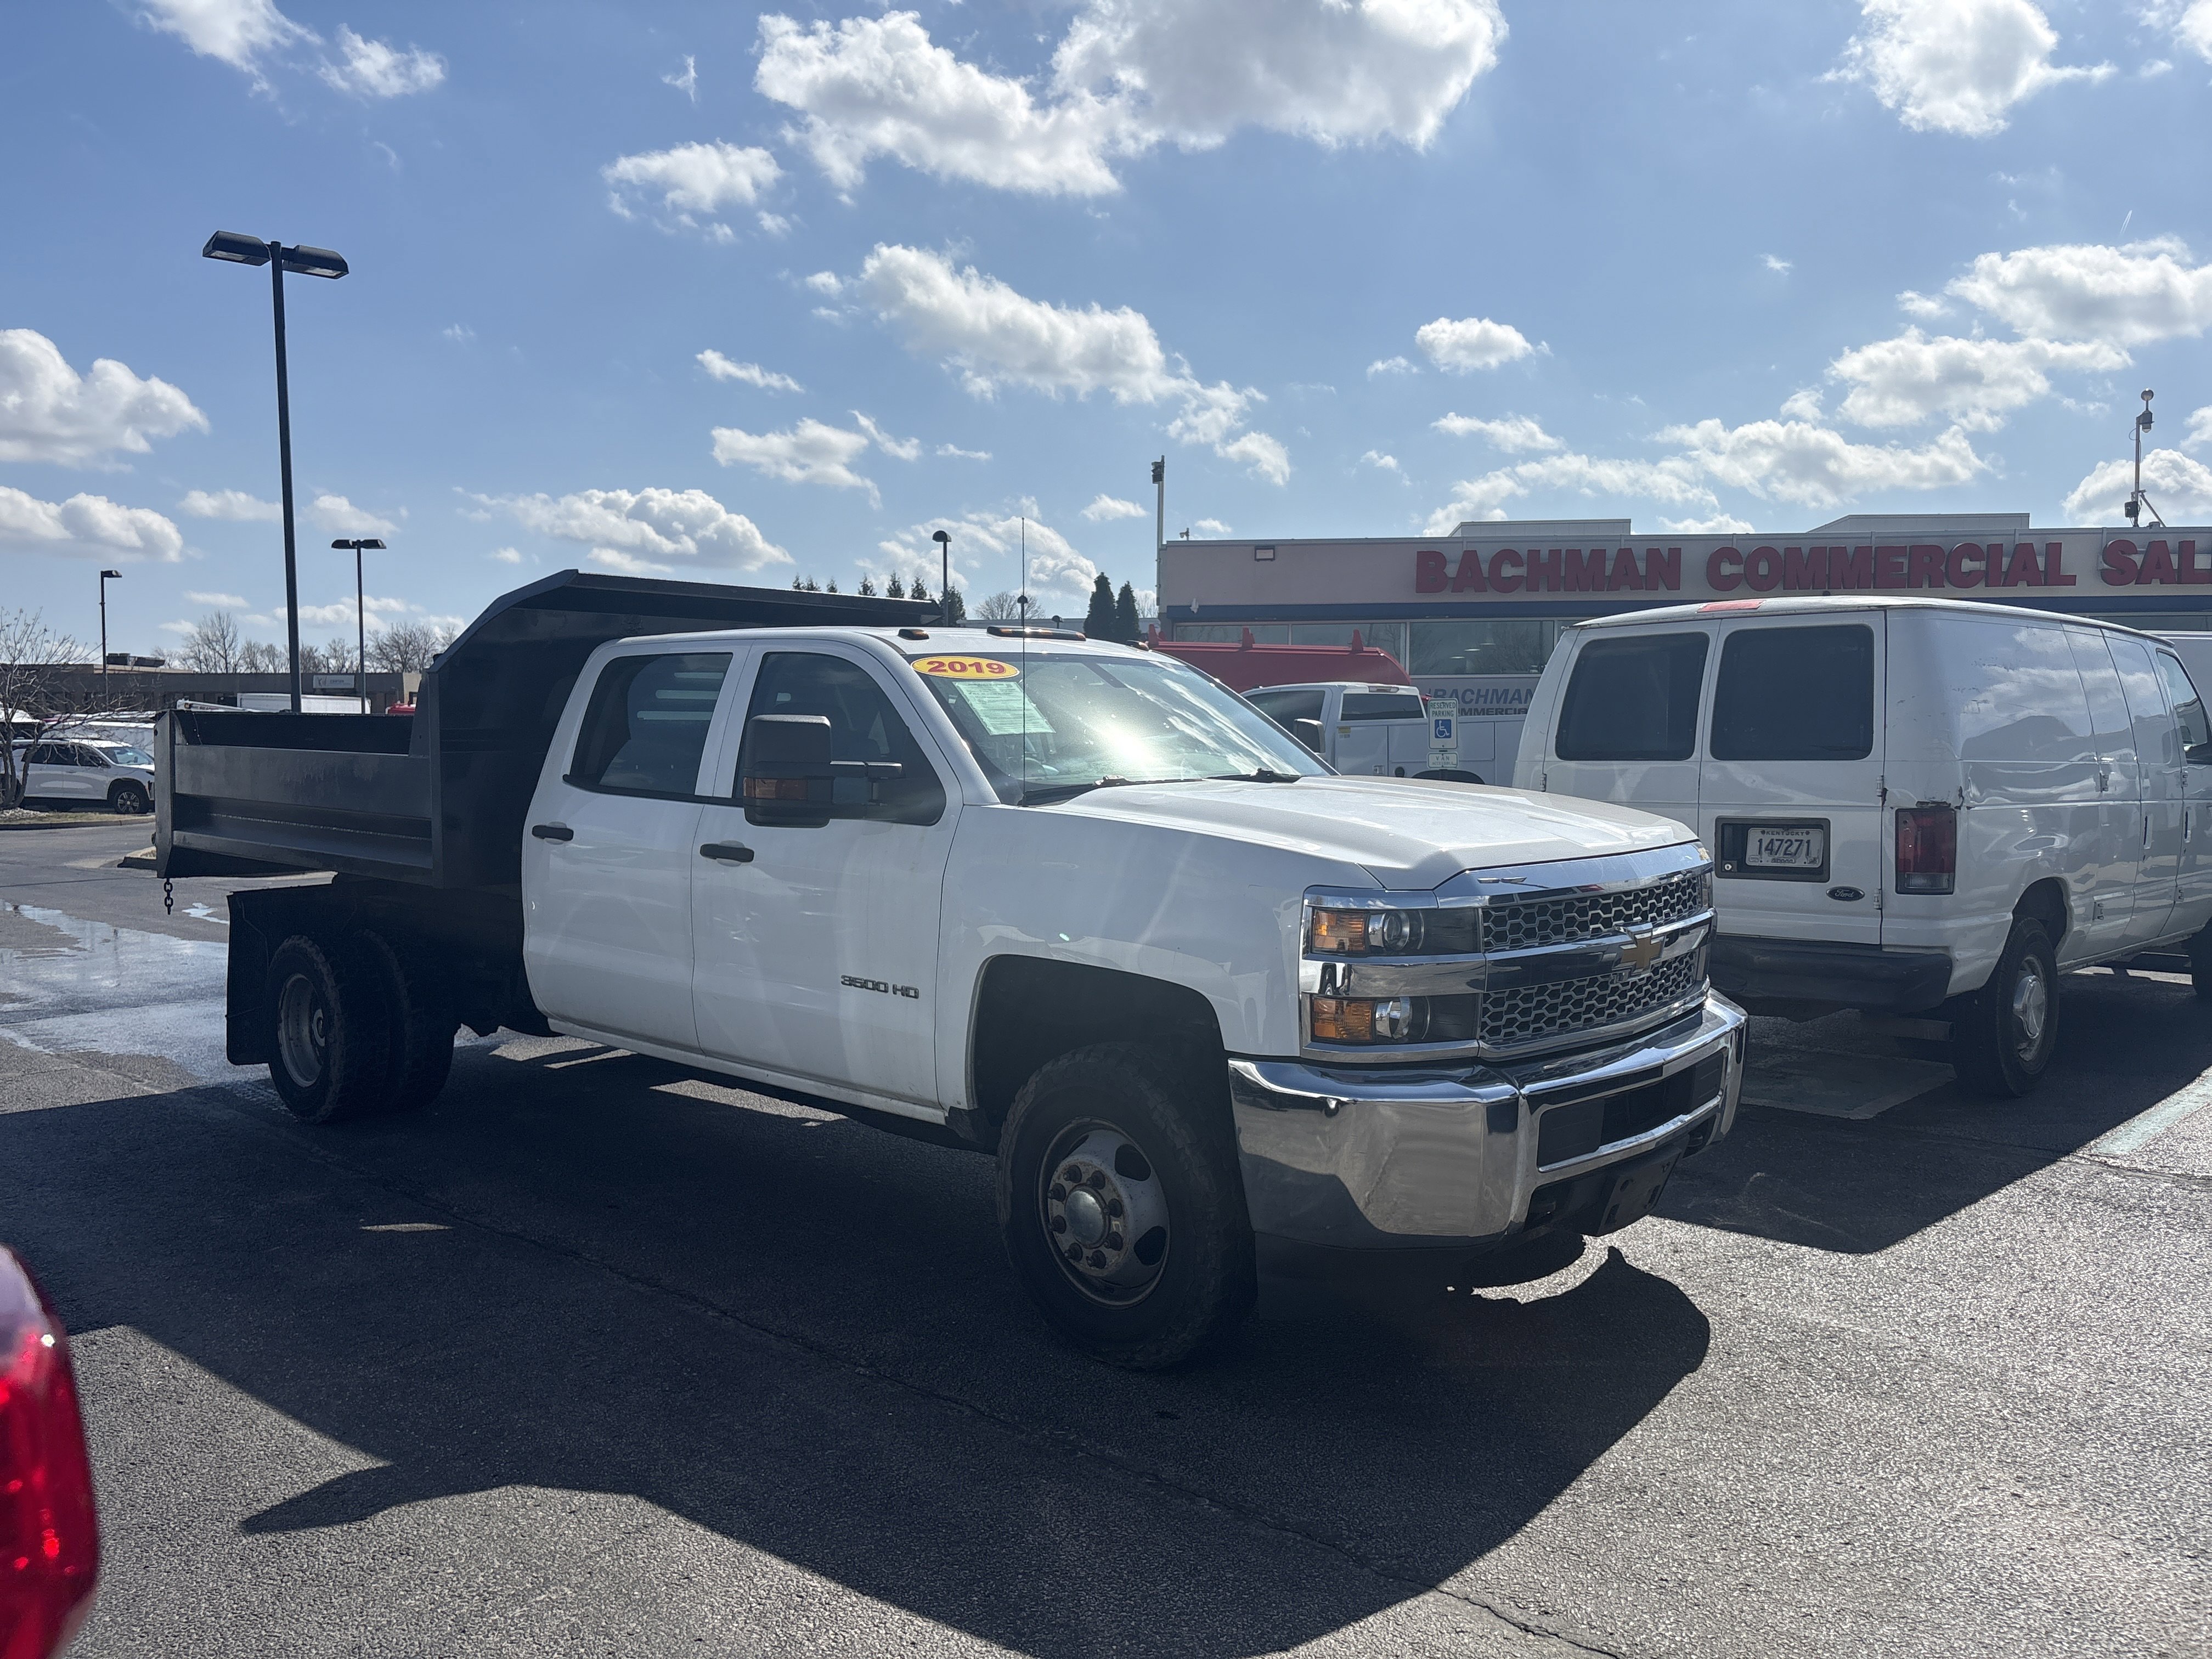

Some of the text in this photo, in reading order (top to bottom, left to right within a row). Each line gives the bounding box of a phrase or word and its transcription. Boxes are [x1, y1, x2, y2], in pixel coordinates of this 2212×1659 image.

[1415, 539, 2212, 593] BACHMAN COMMERCIAL SAL
[926, 660, 1006, 675] 2019
[1458, 708, 1530, 716] MMERCIA
[1758, 838, 1811, 856] 147271
[1834, 889, 1854, 898] Ford
[841, 974, 919, 999] 3500 HD
